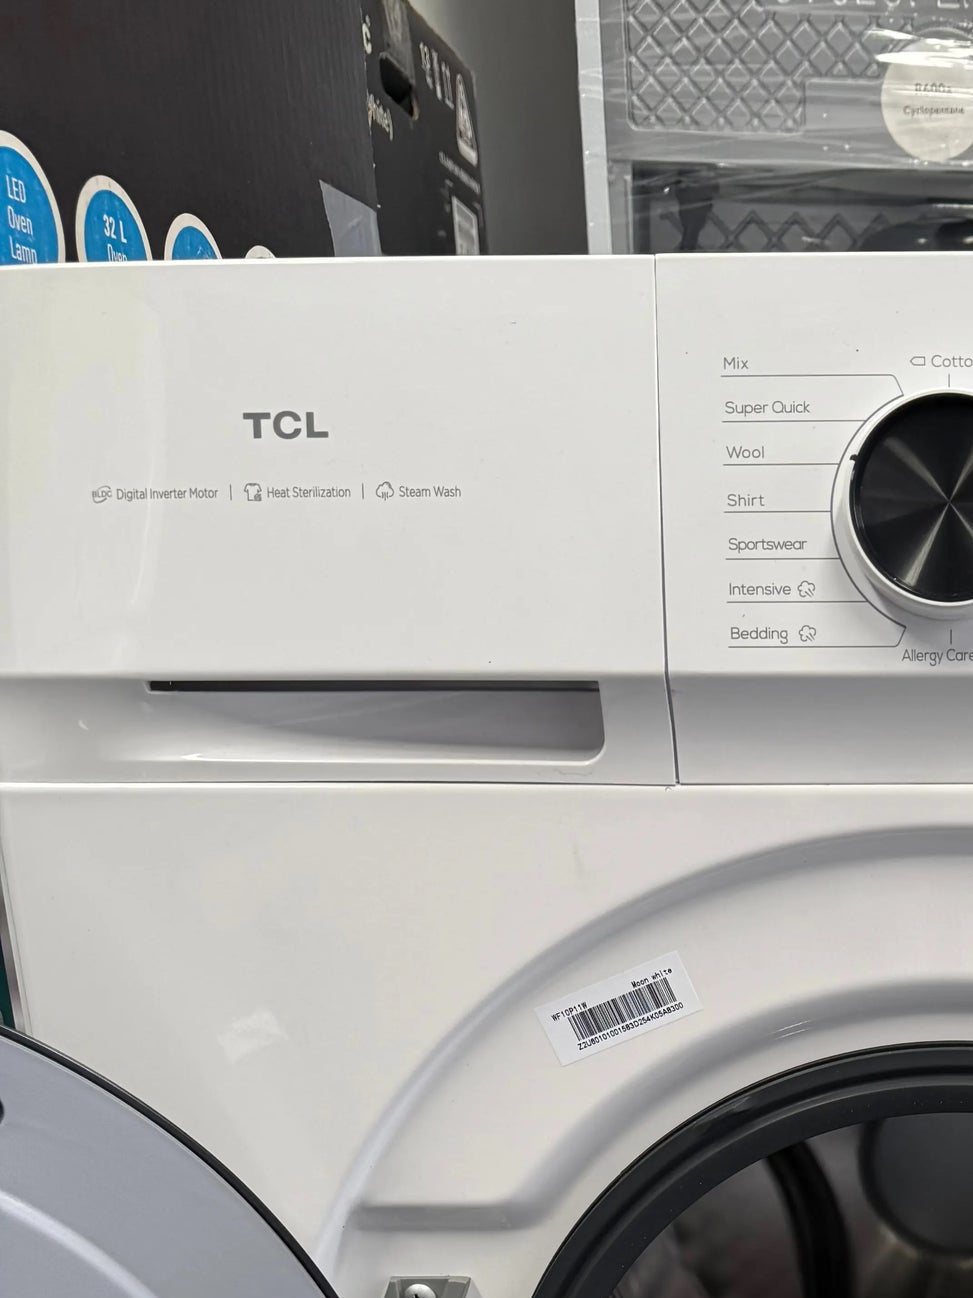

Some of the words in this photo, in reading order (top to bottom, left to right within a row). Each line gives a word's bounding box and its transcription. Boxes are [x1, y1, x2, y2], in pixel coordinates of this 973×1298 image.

[5, 175, 26, 204] LED
[8, 205, 33, 235] Oven
[103, 214, 116, 239] 32
[120, 220, 127, 243] L
[723, 357, 749, 370] Mix
[724, 401, 768, 417] Super
[772, 401, 811, 414] Quick
[243, 409, 329, 439] TCL
[726, 446, 765, 459] Wool
[116, 488, 147, 502] Digital
[150, 488, 187, 499] Inverter
[190, 488, 218, 499] Motor
[267, 486, 290, 498] Heat
[292, 485, 351, 498] Sterilization
[399, 485, 430, 498] Steam
[434, 485, 462, 498] Wash
[727, 494, 765, 507] Shirt
[728, 538, 807, 554] Sportswear
[728, 583, 792, 596] Intensive
[730, 627, 788, 645] Bedding
[902, 649, 944, 666] Allergy
[631, 977, 650, 990] Moon
[651, 968, 673, 981] white
[550, 1002, 588, 1022] WF10P11W
